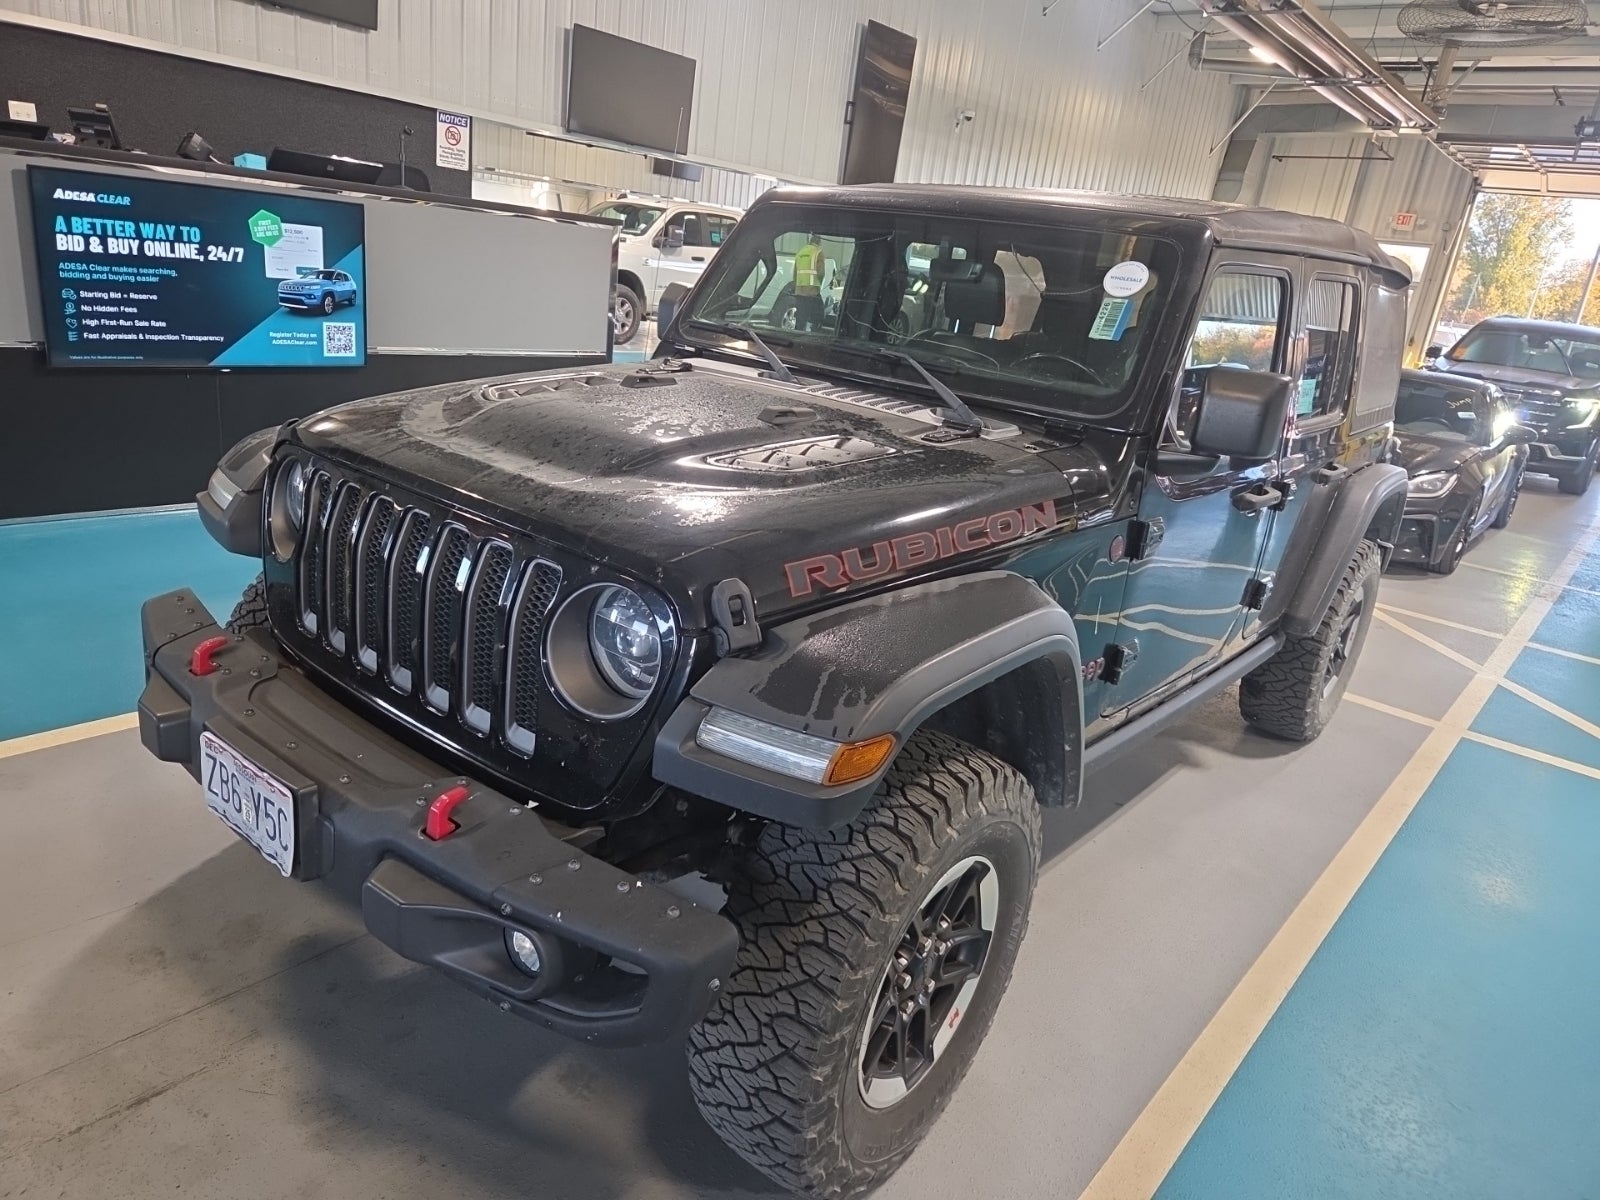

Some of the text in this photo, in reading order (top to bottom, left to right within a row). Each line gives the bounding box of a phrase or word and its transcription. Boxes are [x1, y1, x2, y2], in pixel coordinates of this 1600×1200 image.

[440, 113, 467, 126] NOTICE
[53, 188, 130, 205] ADESA CLEAR
[1396, 214, 1412, 226] EXIT
[55, 216, 201, 242] A BETTER WAY TO
[56, 233, 244, 262] BID & BUY ONLINE, 24/7
[58, 262, 178, 276] ADESA Clear makes searching,
[59, 270, 90, 280] bidding
[108, 273, 135, 282] buying
[1110, 275, 1143, 283] WHOLESALE
[80, 290, 108, 300] Starting
[82, 318, 100, 326] High
[181, 334, 224, 342] Transparency
[784, 500, 1057, 598] RUBICON
[204, 740, 220, 754] DEC
[205, 752, 288, 852] ZB6 Y5C
